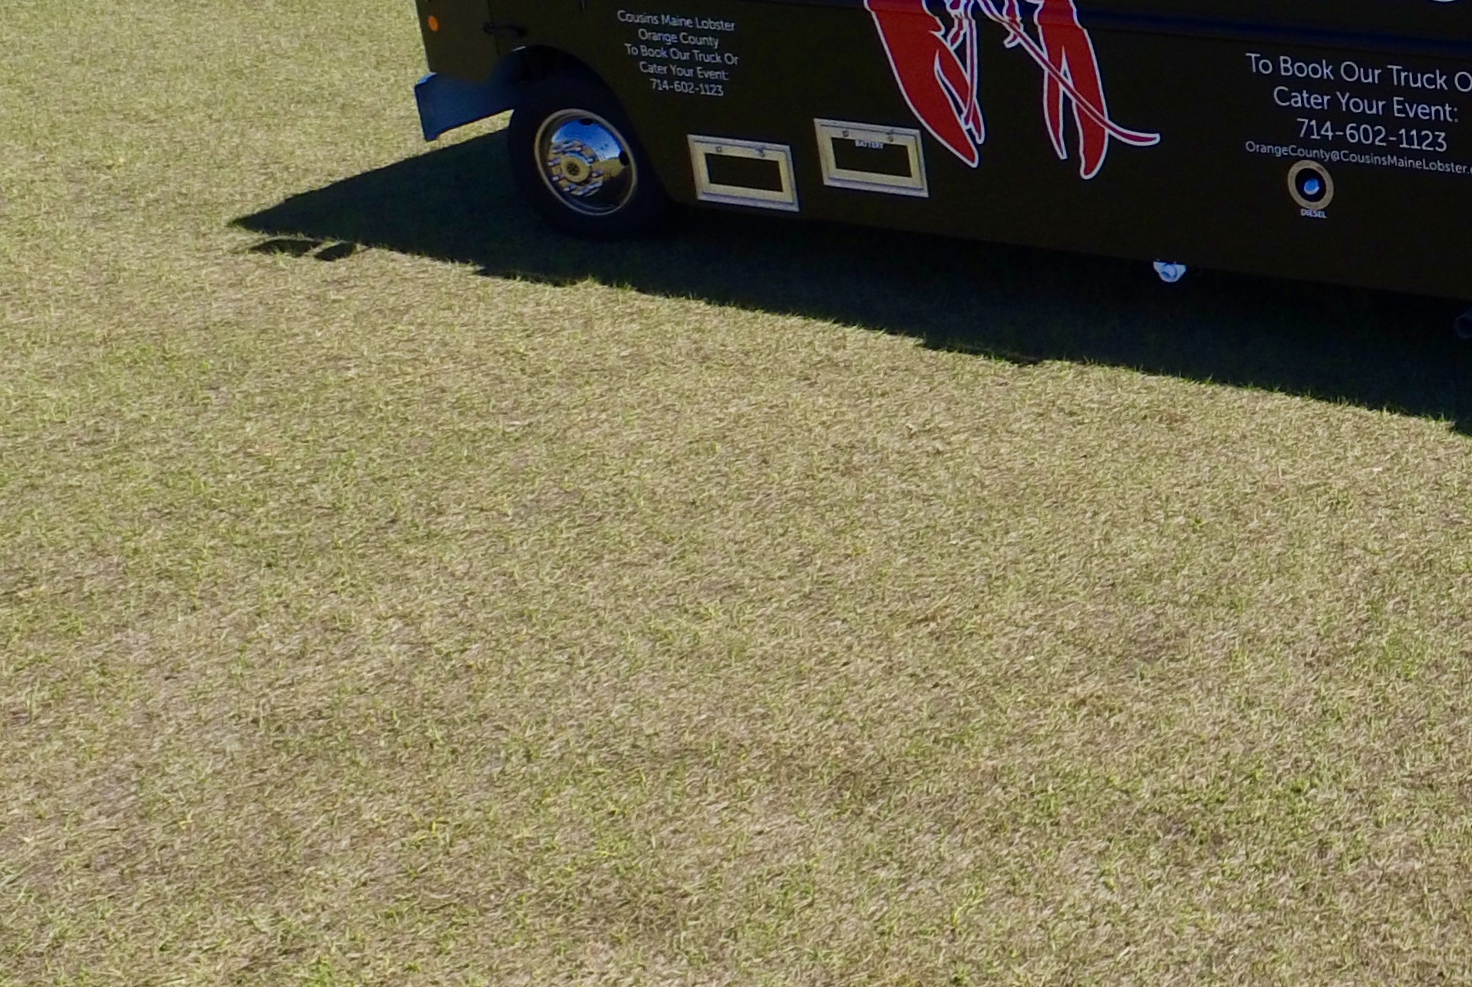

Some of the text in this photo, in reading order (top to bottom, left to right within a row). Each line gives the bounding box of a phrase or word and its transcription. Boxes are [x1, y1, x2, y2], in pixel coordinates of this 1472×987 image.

[617, 10, 735, 31] Cousins Maine Lobster
[638, 28, 719, 49] Orange County
[624, 43, 739, 65] To Book Our Truck Or
[639, 61, 668, 74] Cater
[669, 65, 694, 77] Your
[1246, 53, 1273, 74] To
[1280, 56, 1334, 80] Book
[1340, 61, 1382, 84] Our
[1387, 65, 1448, 90] Truck
[650, 78, 724, 96] 714-602-1123
[1273, 86, 1459, 122] Cater Your Event:
[1297, 118, 1448, 152] 714-602-1123
